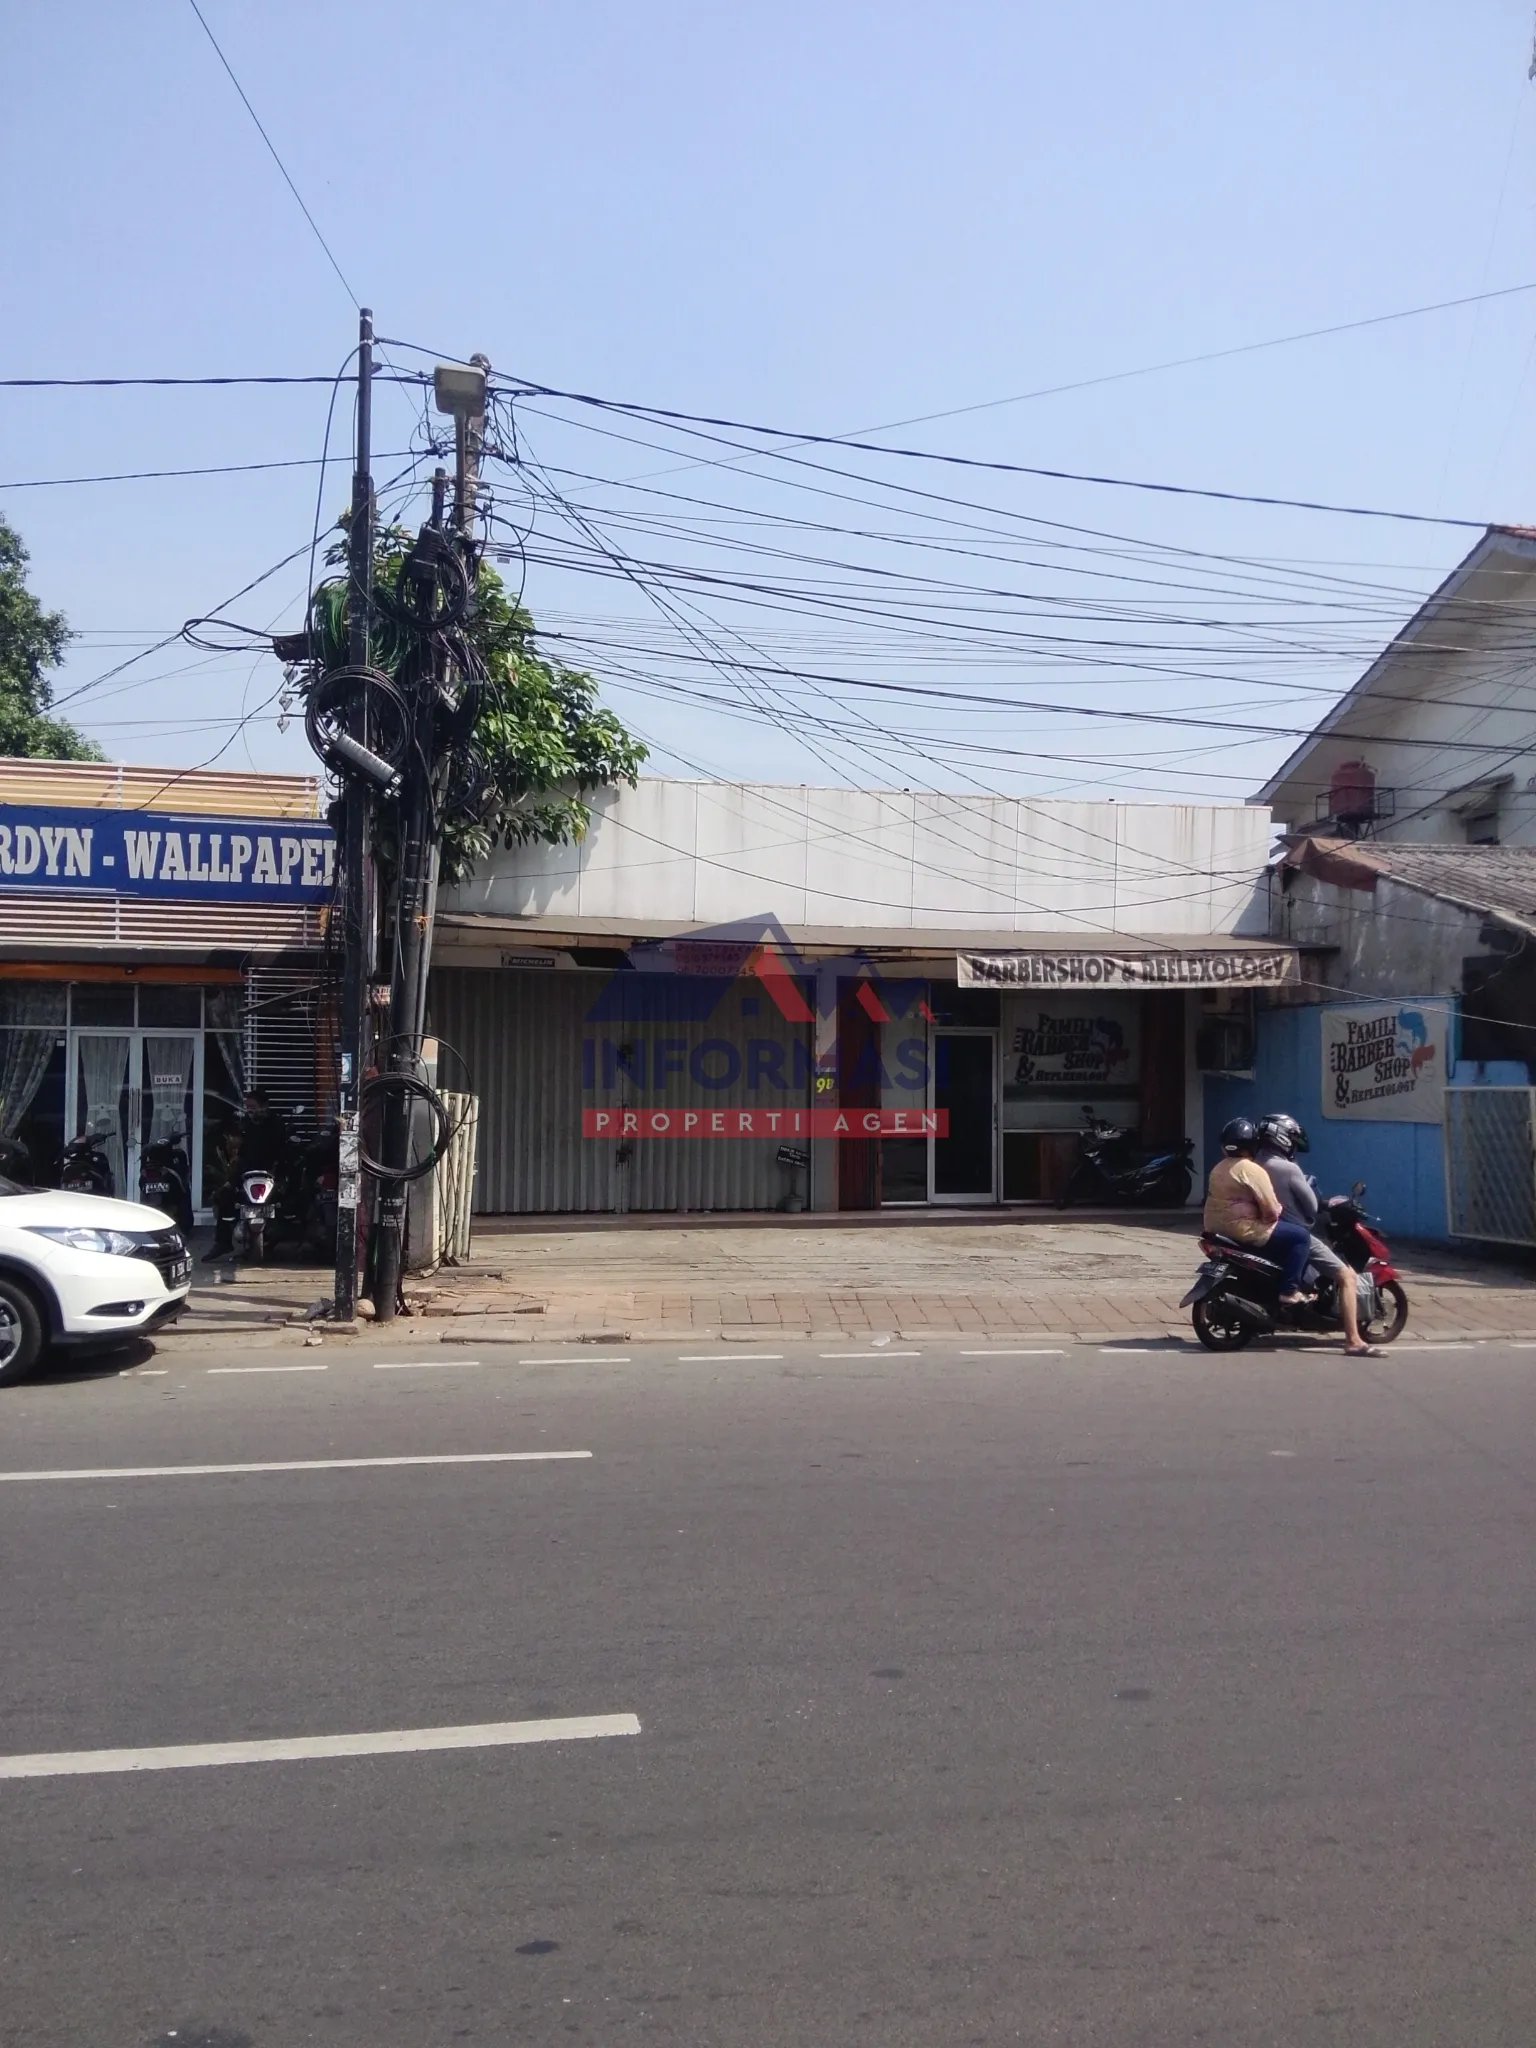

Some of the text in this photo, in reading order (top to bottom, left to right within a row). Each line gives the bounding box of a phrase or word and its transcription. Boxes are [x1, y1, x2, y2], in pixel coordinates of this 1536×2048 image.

[103, 856, 115, 866] -
[972, 955, 1286, 983] BARBERSHOP & REFLEXOLOGY
[1346, 1016, 1397, 1045] FAMILI
[1332, 1037, 1396, 1073] BARBER
[1374, 1058, 1411, 1083] SHOP
[1335, 1073, 1416, 1104] & REFLEXOLOGY
